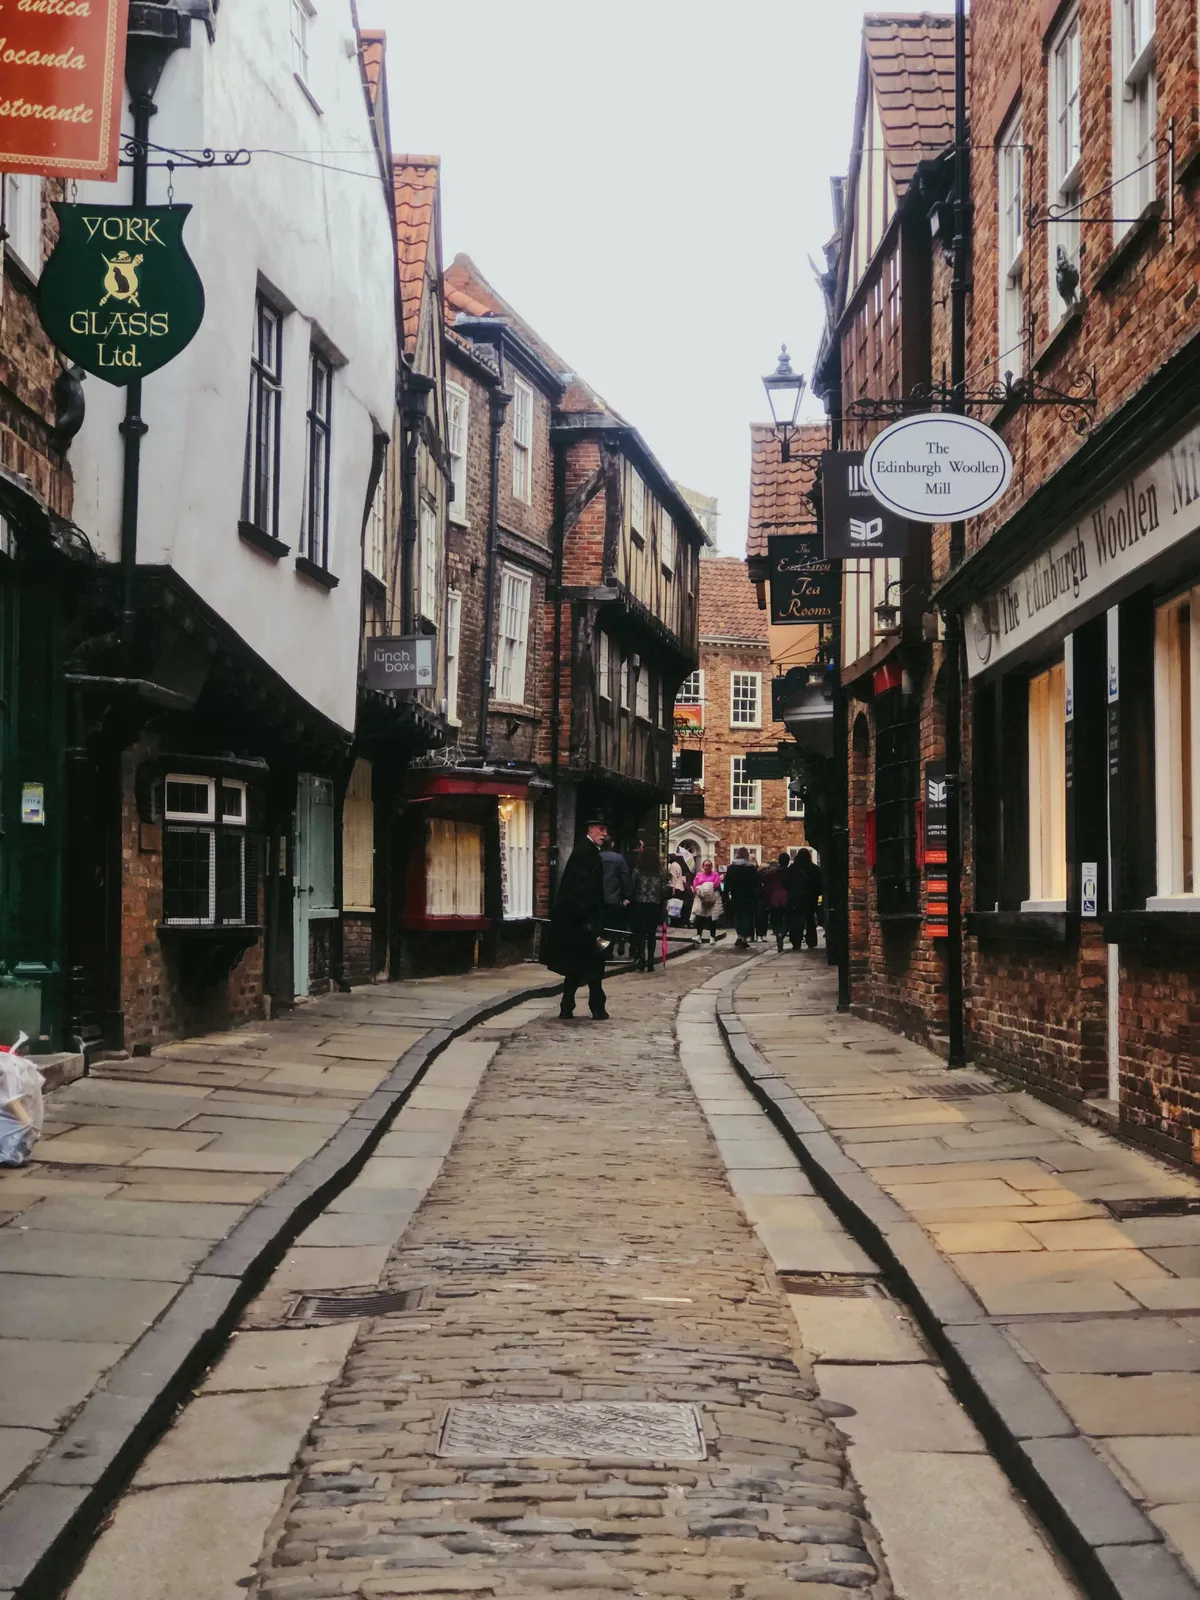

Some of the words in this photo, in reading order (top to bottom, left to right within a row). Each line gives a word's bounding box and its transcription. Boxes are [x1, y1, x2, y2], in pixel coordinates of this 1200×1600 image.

[82, 216, 166, 247] YORK
[69, 310, 169, 340] GLASS
[98, 343, 142, 367] Ltd.
[926, 441, 950, 454] The
[876, 460, 942, 476] Edinburgh
[949, 460, 999, 473] Woollen
[925, 481, 951, 495] Mill
[849, 517, 883, 541] 3D
[795, 543, 811, 554] The
[1000, 588, 1020, 634] The
[1025, 527, 1088, 620] Edinburgh
[1092, 481, 1160, 568] Woollen
[791, 577, 821, 596] Tea
[779, 598, 832, 617] Rooms
[373, 650, 410, 662] lunch
[385, 661, 409, 673] box
